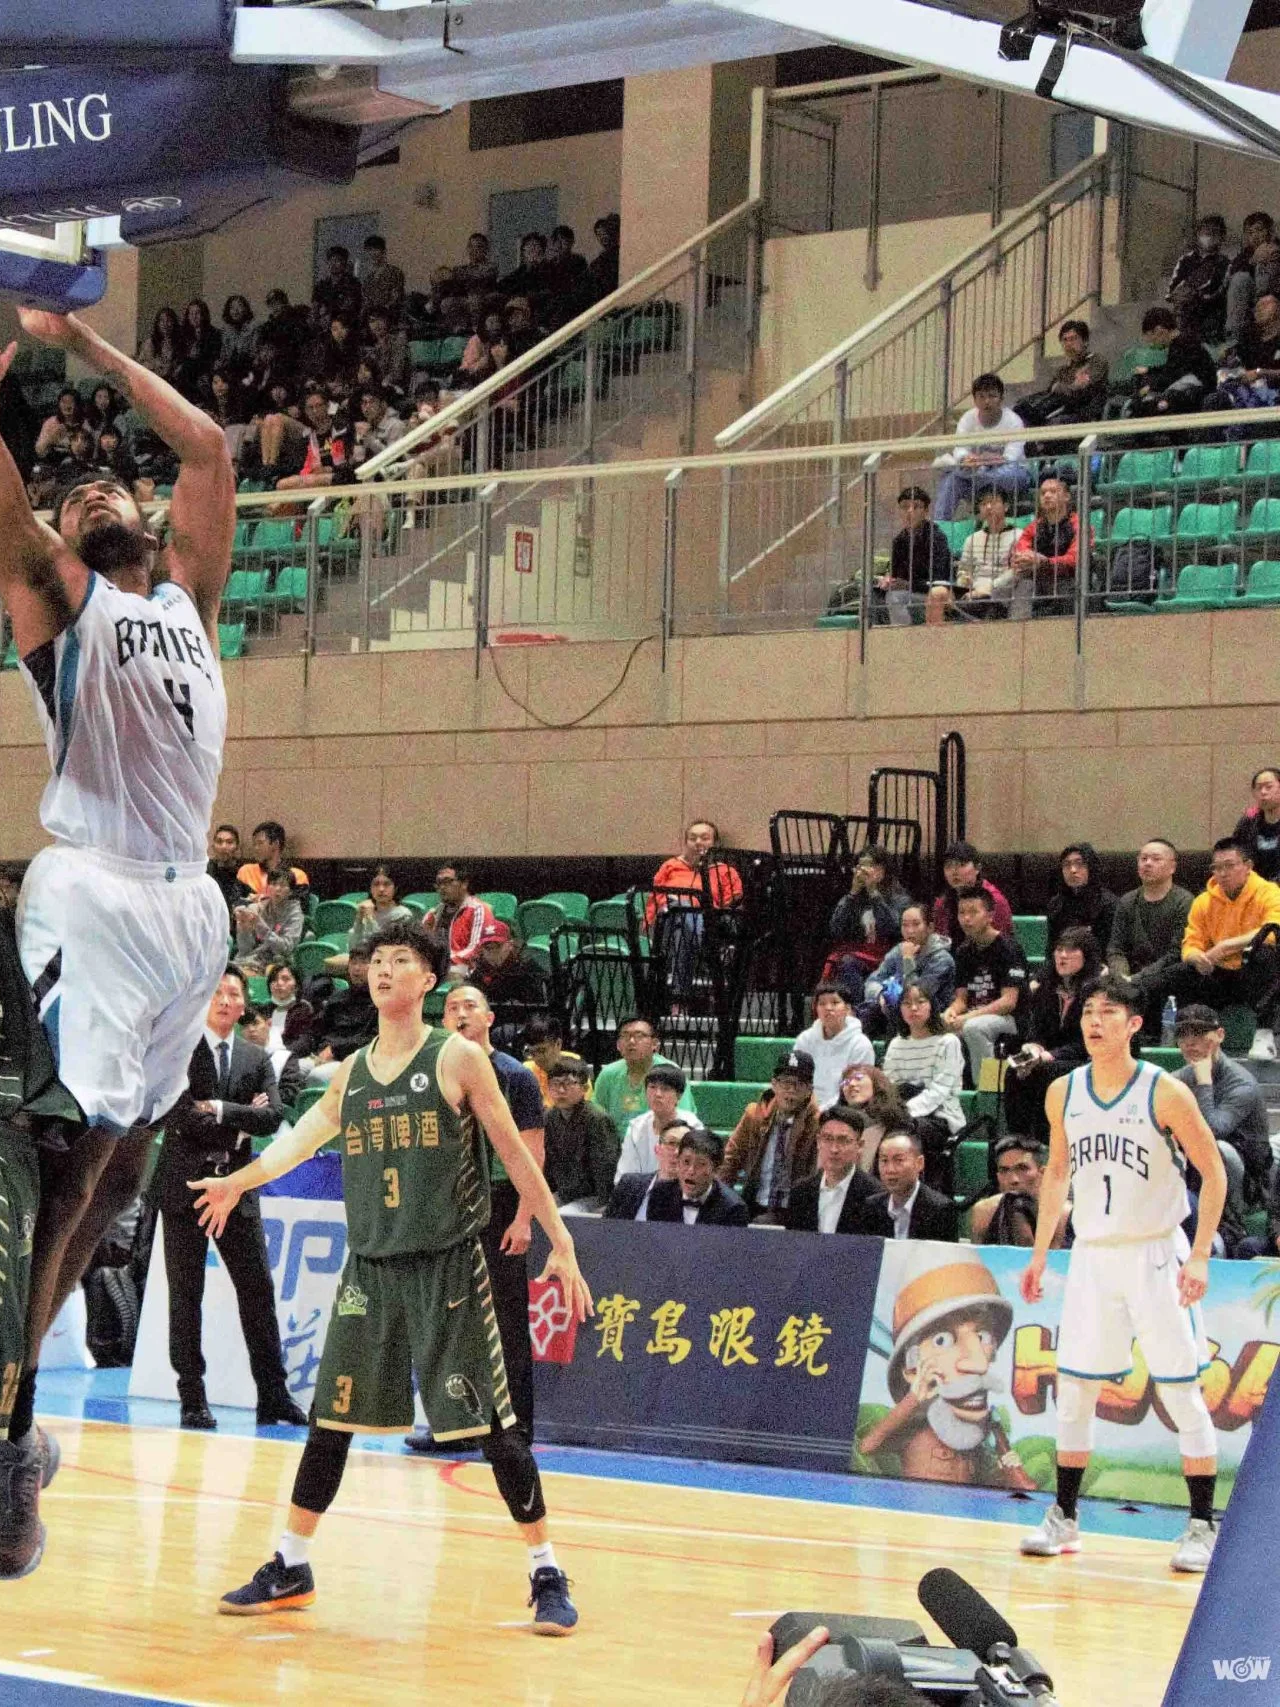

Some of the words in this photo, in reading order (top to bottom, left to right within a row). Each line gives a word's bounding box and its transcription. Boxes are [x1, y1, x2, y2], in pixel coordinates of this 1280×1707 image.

[345, 1110, 439, 1156] 台灣啤酒
[1069, 1133, 1150, 1181] BRAVES
[383, 1167, 401, 1208] 3
[1102, 1174, 1112, 1215] 1
[594, 1294, 832, 1377] 寶島眼鏡
[332, 1375, 353, 1414] 3
